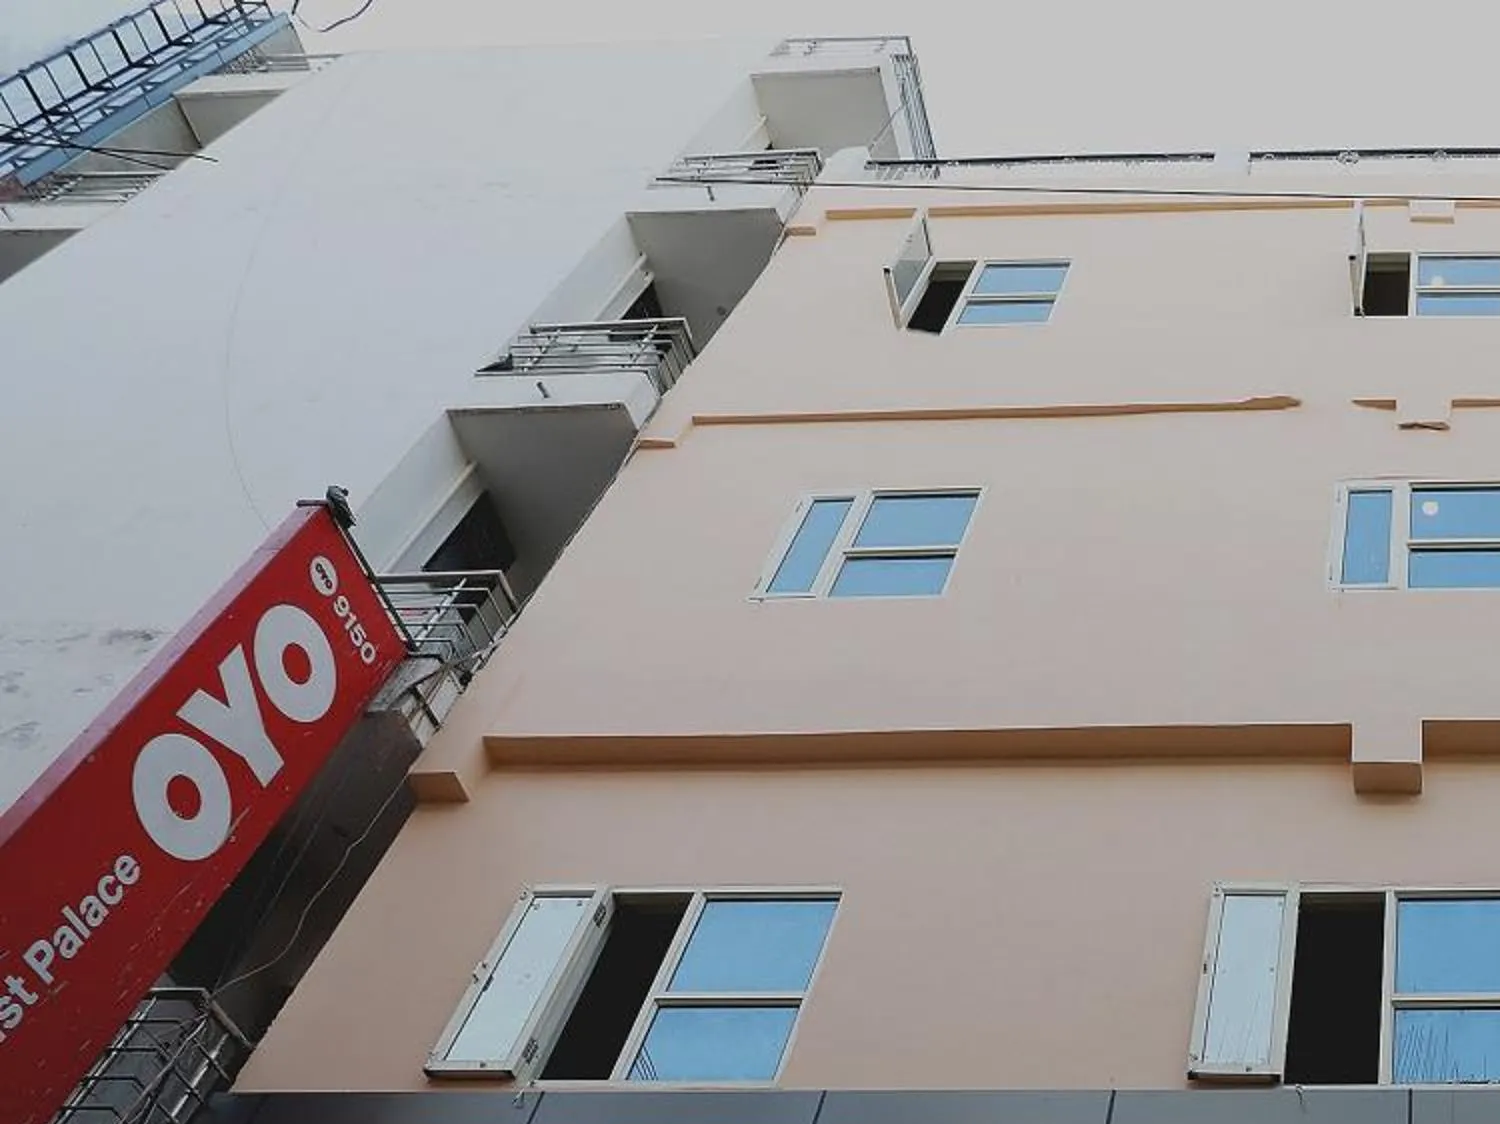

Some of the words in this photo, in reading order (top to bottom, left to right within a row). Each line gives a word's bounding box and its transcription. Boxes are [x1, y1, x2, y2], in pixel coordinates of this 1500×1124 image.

[333, 595, 376, 664] 9150
[132, 604, 337, 860] OYO
[0, 975, 39, 1043] st
[22, 855, 141, 985] Palace
